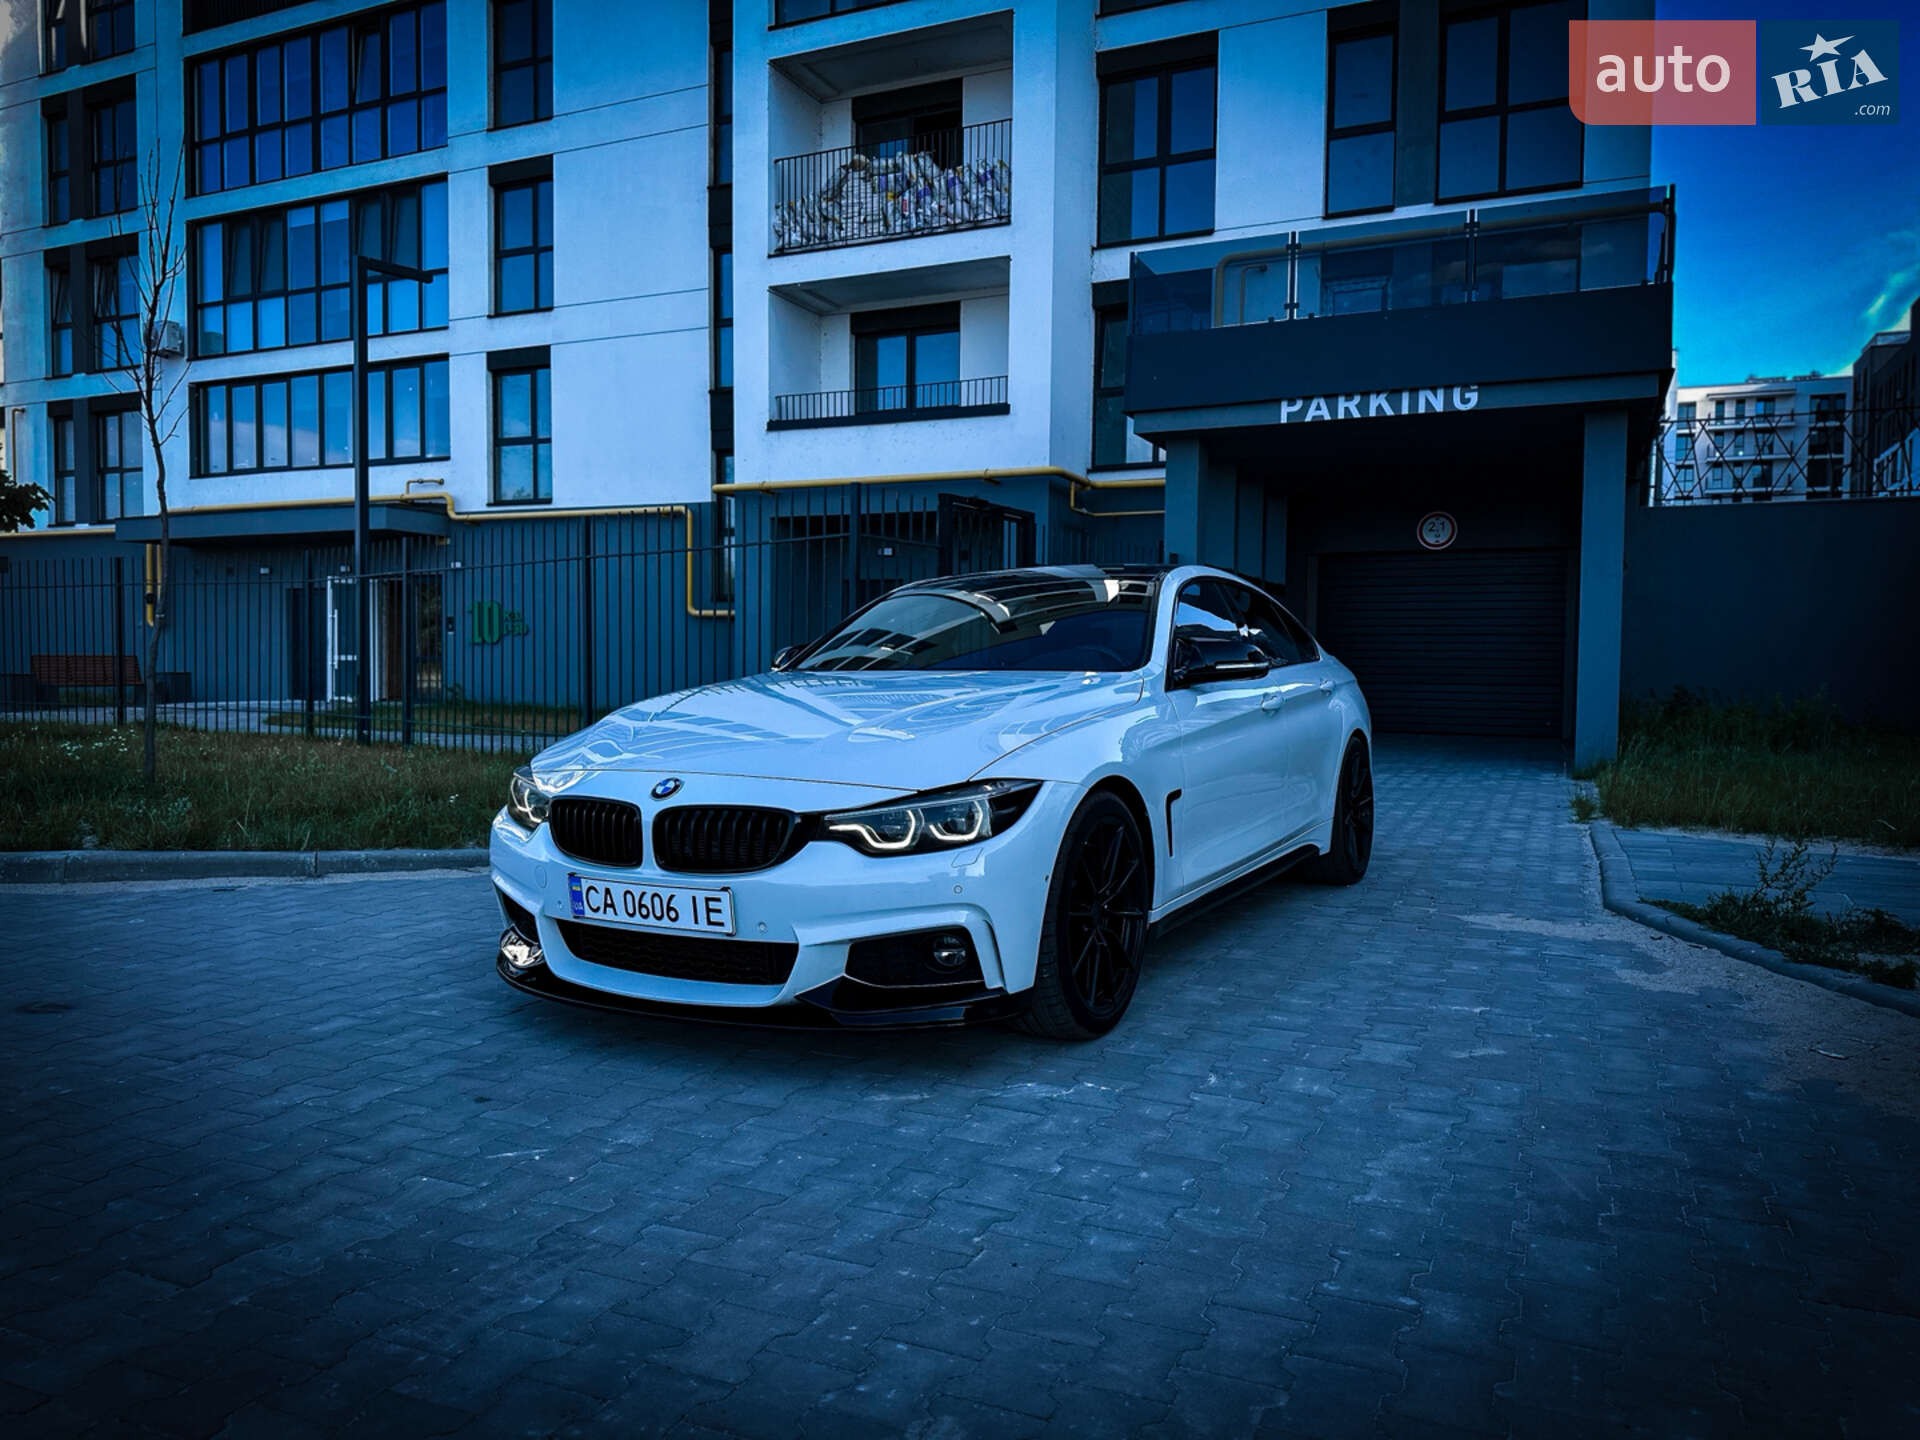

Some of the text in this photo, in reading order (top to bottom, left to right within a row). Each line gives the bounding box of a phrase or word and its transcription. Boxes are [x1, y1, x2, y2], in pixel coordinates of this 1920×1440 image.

[1280, 385, 1479, 423] PARKING
[585, 885, 725, 927] CA 0606 IE
